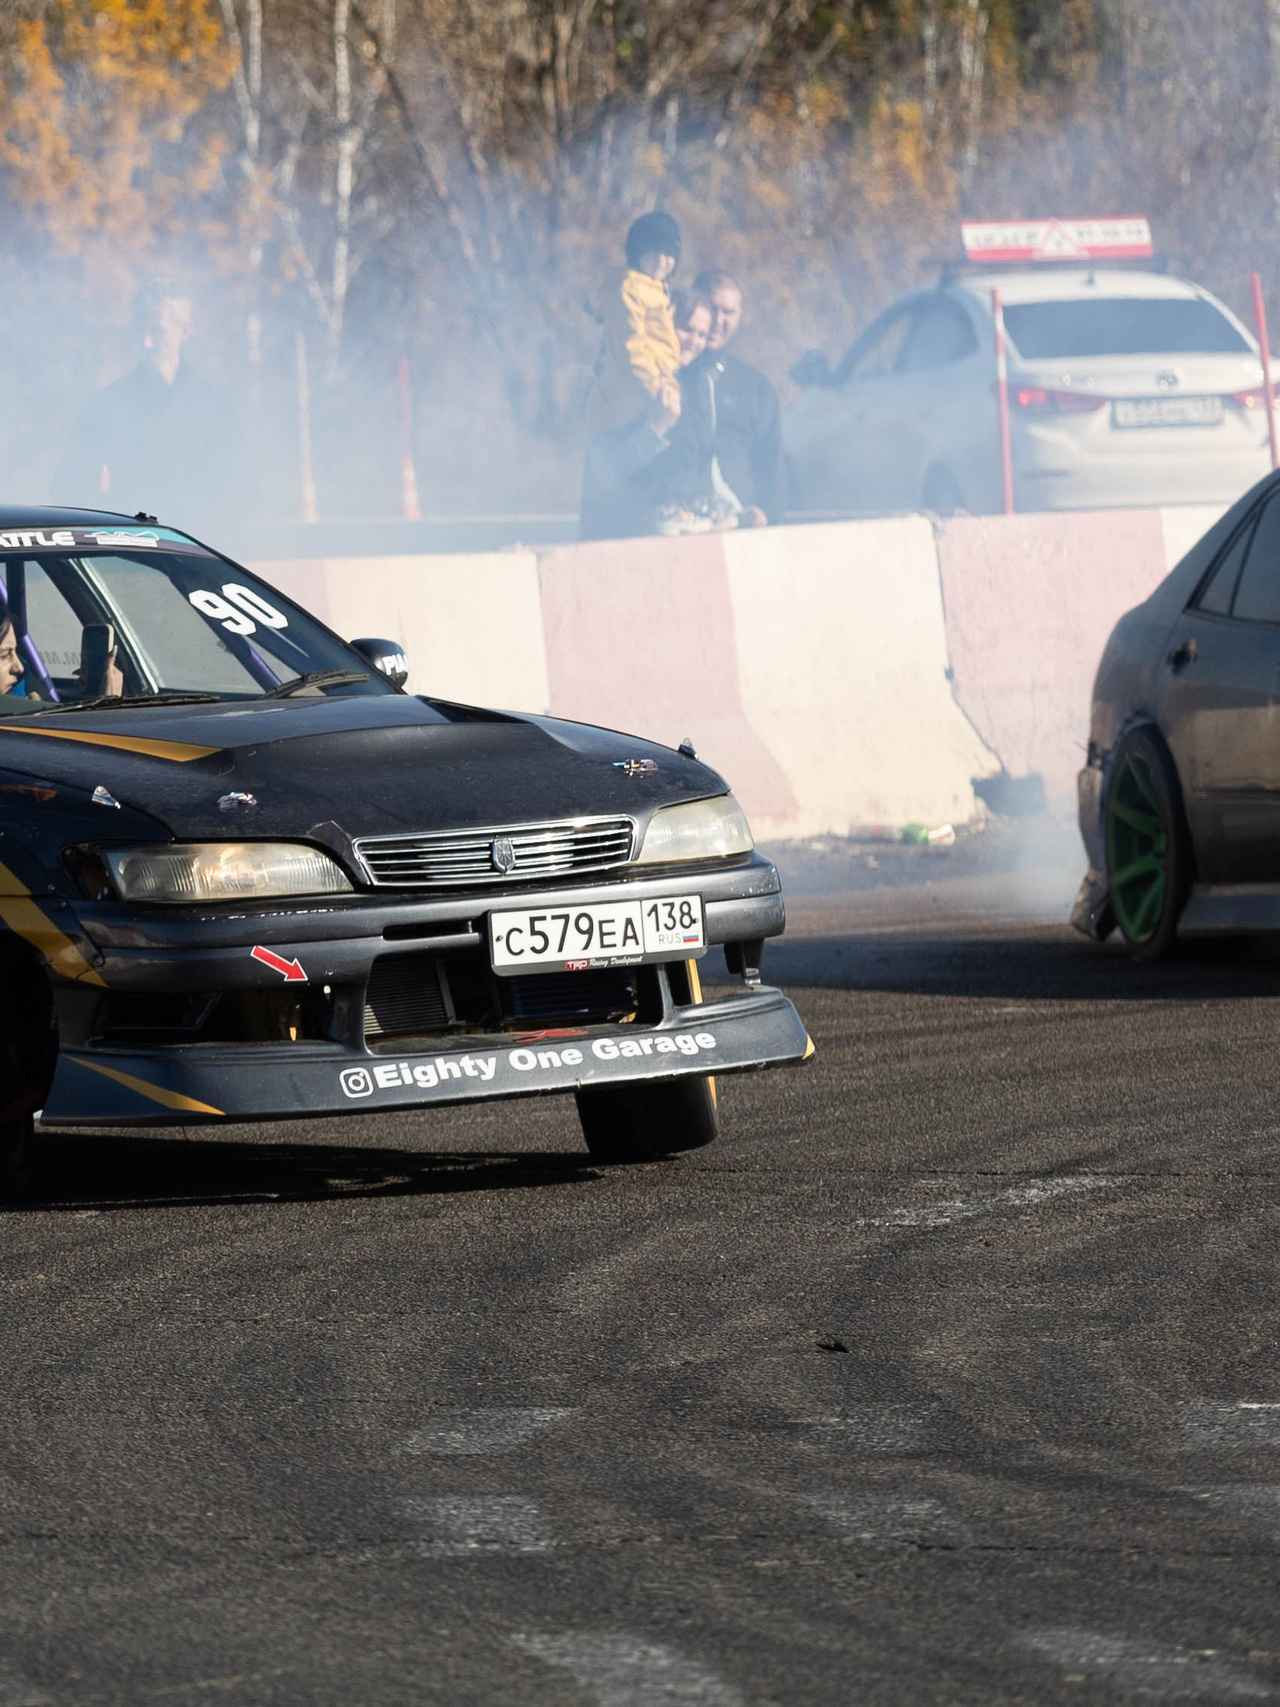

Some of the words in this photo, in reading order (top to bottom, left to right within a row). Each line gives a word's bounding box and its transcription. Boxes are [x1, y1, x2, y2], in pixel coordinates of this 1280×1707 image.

[188, 582, 289, 636] 90
[505, 912, 640, 956] С579ЕА
[647, 900, 694, 932] 138
[658, 932, 682, 944] RUS
[372, 1054, 497, 1089] Eighty
[508, 1048, 584, 1071] One
[591, 1032, 717, 1061] Garage
